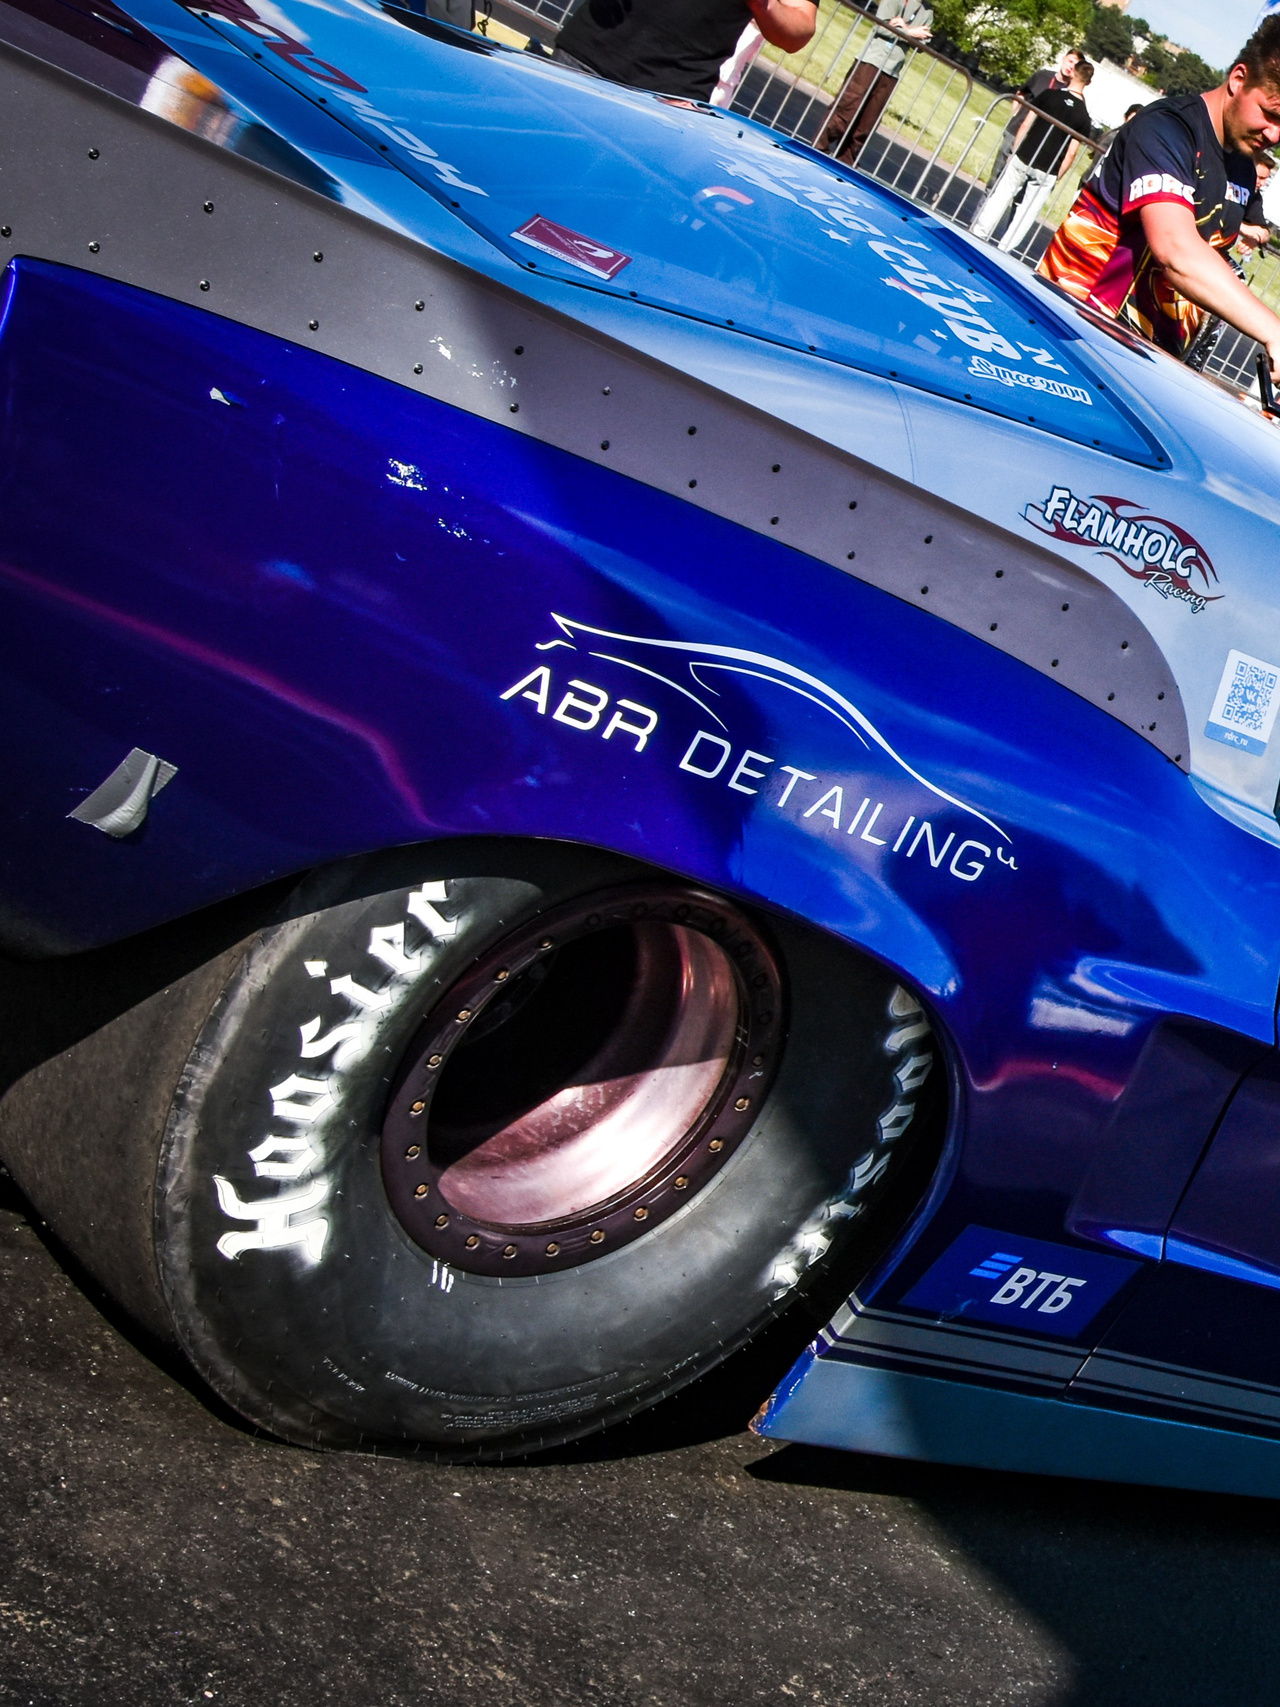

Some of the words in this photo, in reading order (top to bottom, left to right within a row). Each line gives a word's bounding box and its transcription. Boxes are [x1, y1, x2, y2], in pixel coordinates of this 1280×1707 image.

[867, 240, 1023, 361] CLUB
[1043, 485, 1199, 579] FLAMHOLC
[1144, 571, 1209, 613] Racing
[499, 666, 659, 752] ABR
[679, 730, 992, 882] DETAILING
[990, 1267, 1087, 1314] ВТБ
